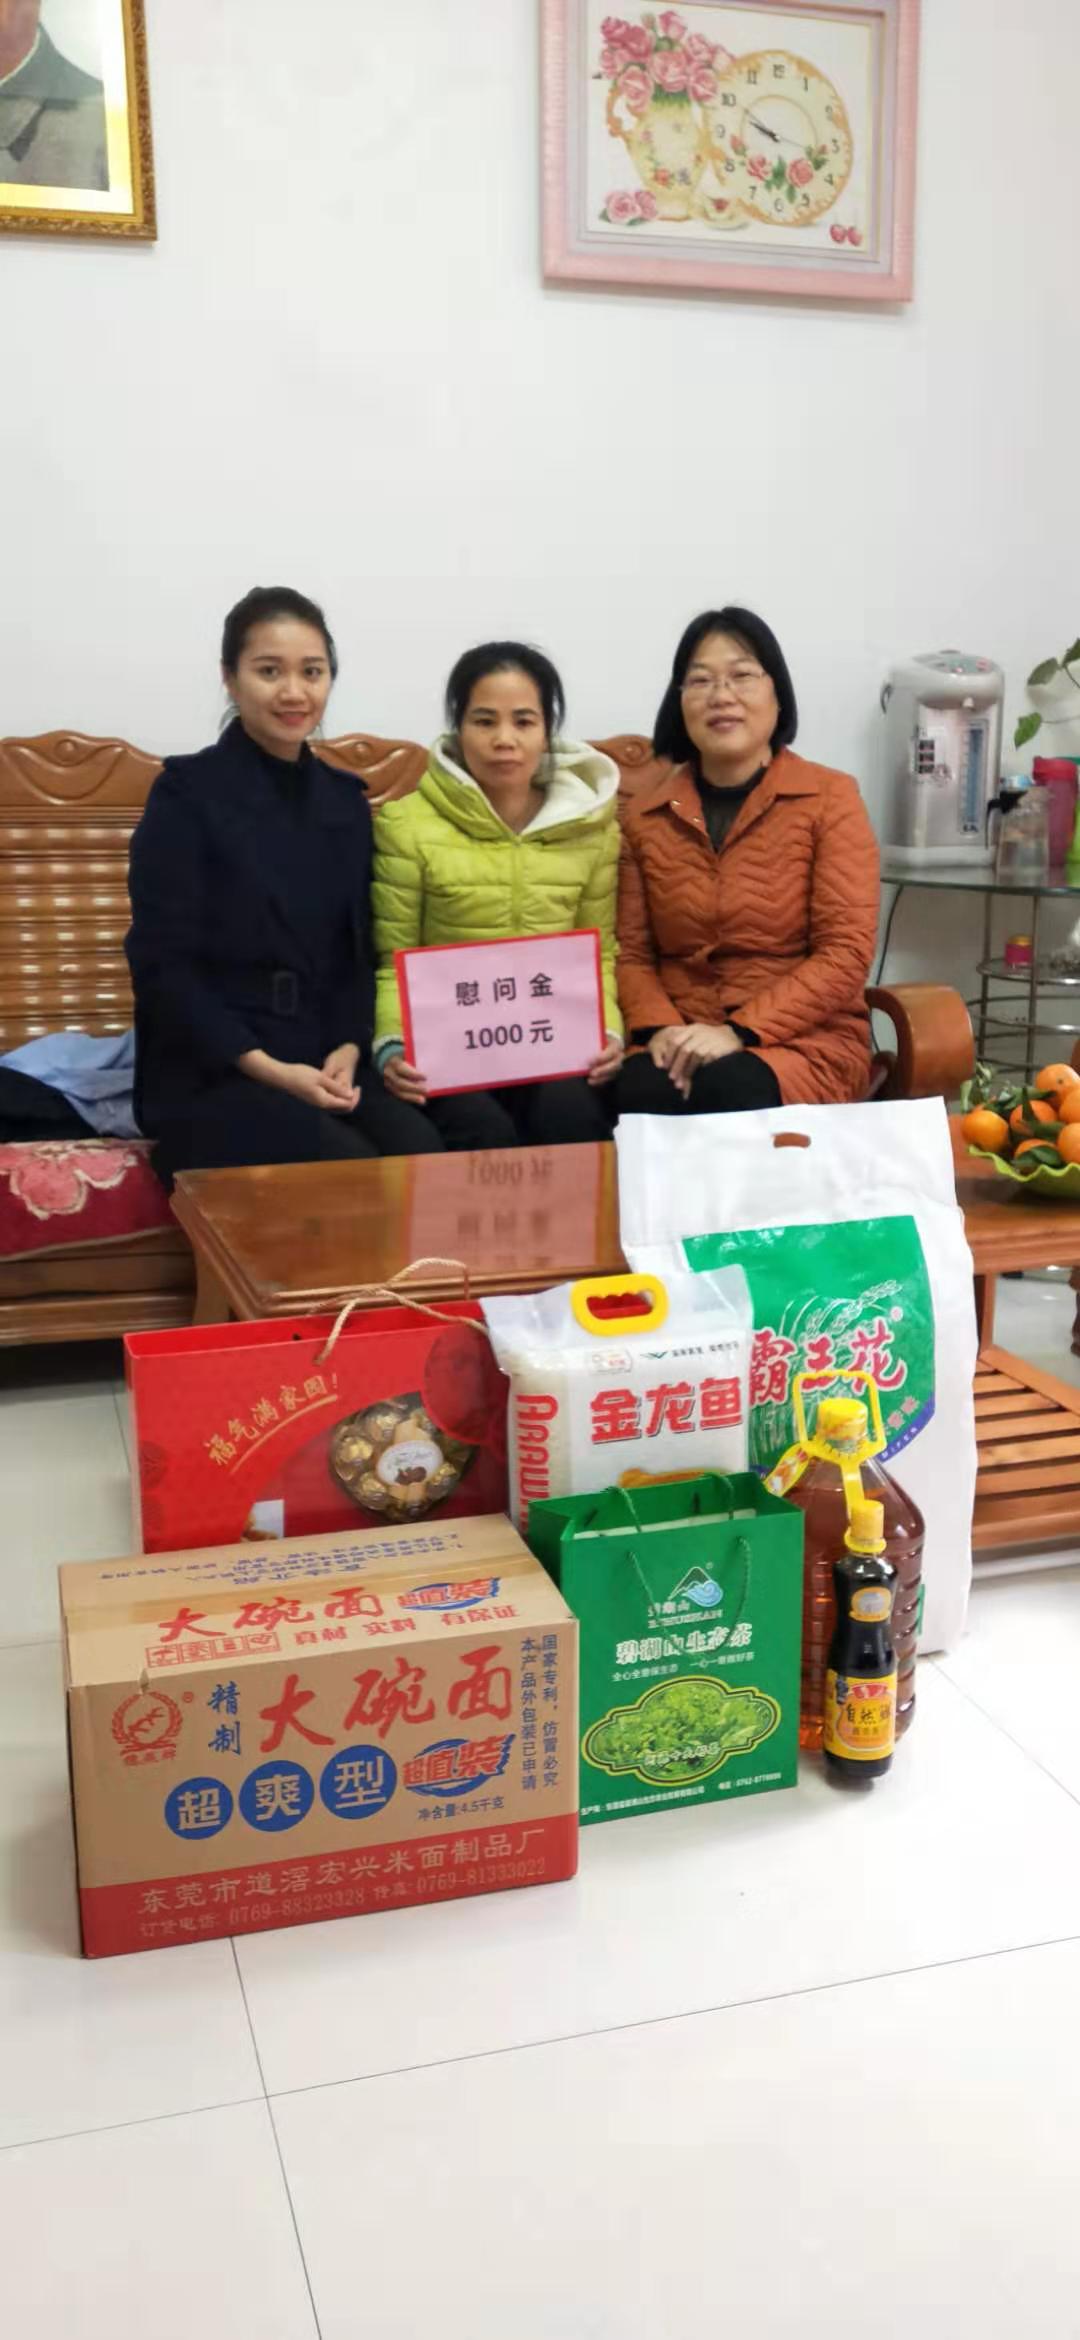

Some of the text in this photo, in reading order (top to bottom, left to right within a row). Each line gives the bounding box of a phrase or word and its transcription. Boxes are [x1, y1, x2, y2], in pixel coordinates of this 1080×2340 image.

[455, 972, 554, 1006] 慰问金
[590, 1376, 742, 1444] 金龙鱼
[159, 1587, 385, 1643] 大碗面
[396, 1577, 493, 1608] 超值装
[440, 1603, 519, 1627] 有保证
[207, 1680, 242, 1756] 精制
[259, 1644, 512, 1754] 大碗面
[520, 1637, 537, 1790] 本产品外包装已申请
[402, 1733, 511, 1786] 超值装
[177, 1755, 388, 1831] 超爽型
